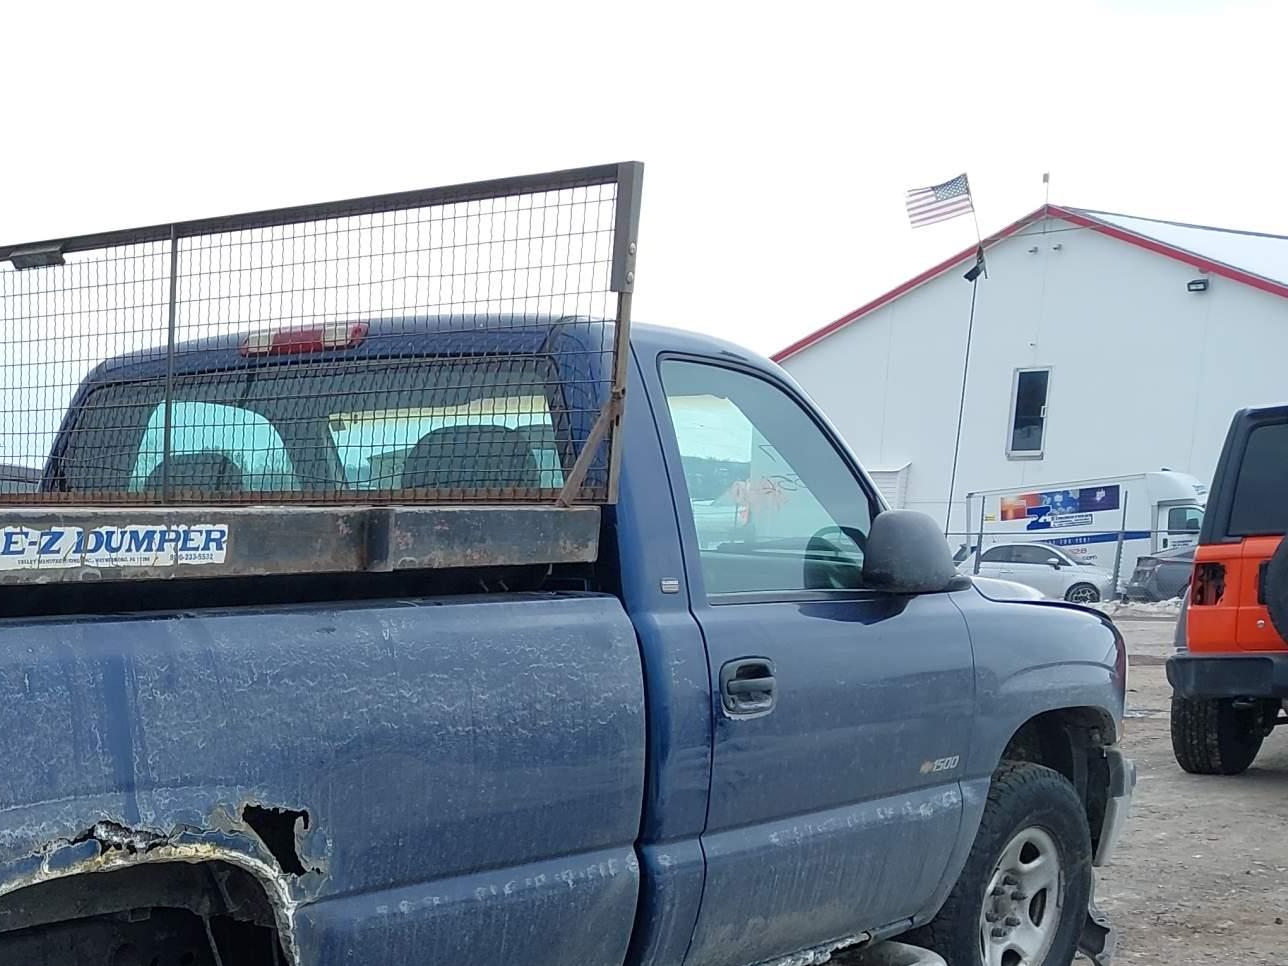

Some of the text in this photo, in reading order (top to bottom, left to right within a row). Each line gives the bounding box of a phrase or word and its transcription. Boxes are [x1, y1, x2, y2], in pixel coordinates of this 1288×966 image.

[0, 529, 227, 556] E-Z DUMPER
[932, 755, 960, 772] 1500
